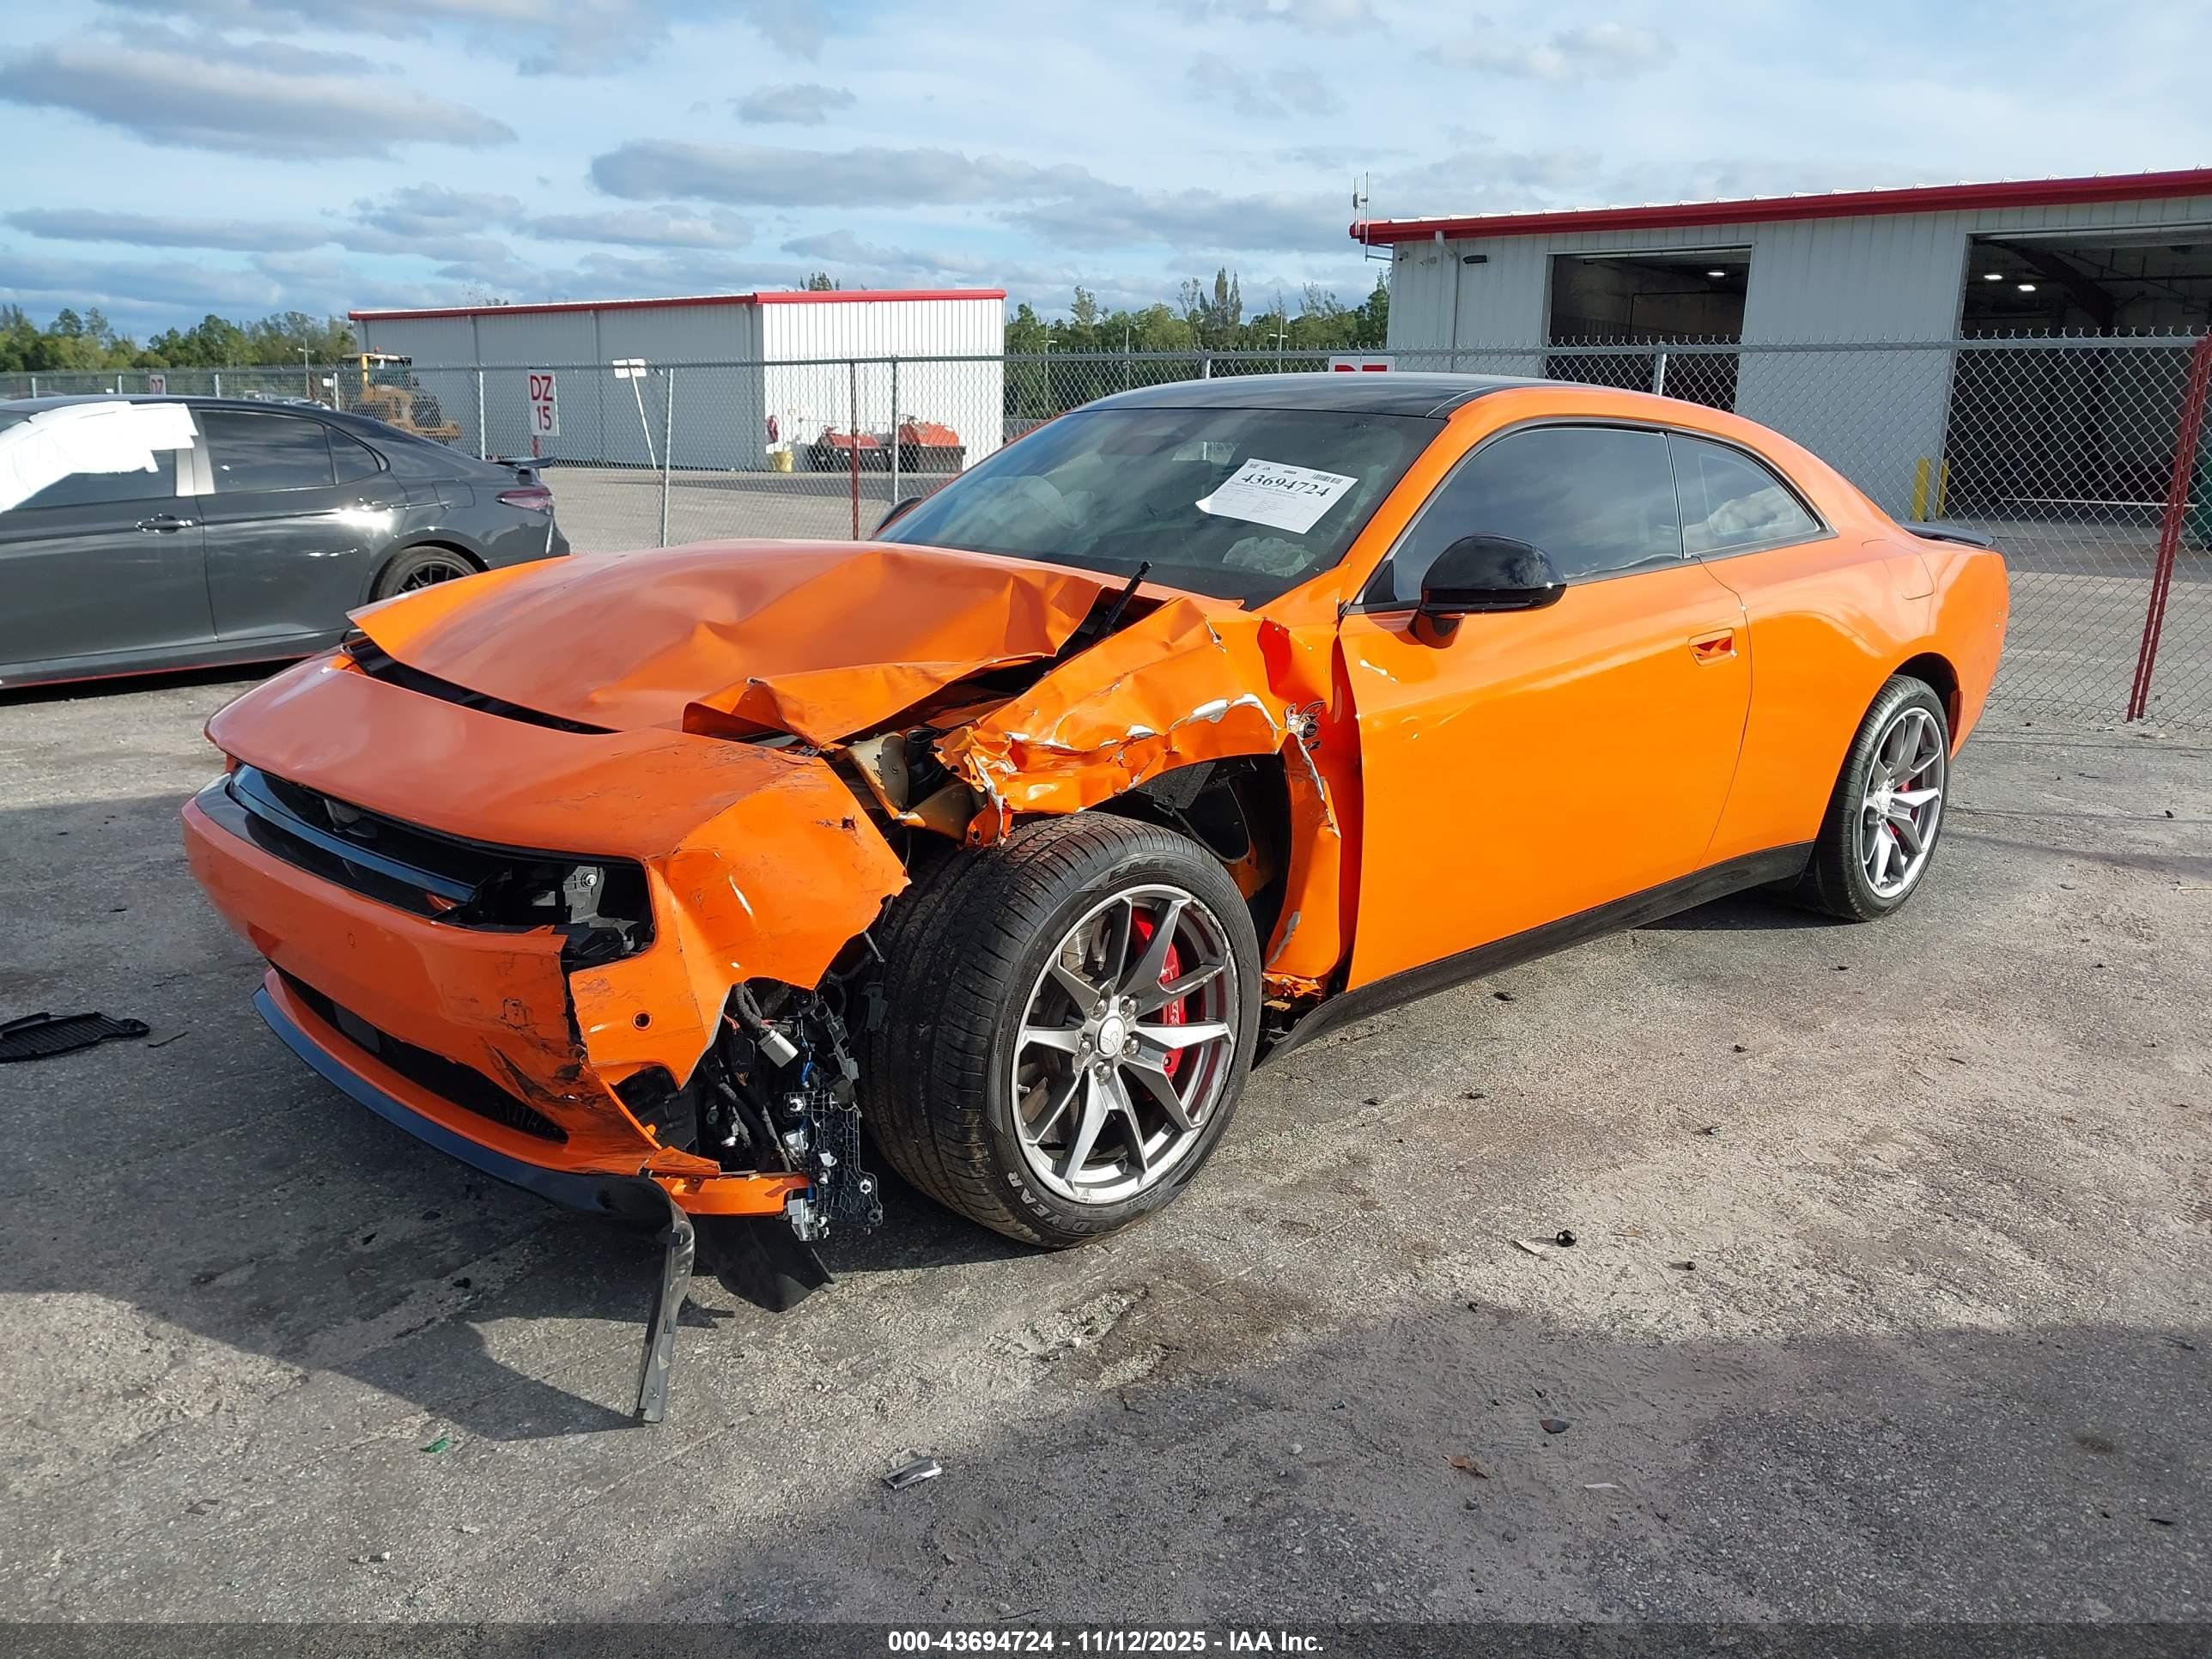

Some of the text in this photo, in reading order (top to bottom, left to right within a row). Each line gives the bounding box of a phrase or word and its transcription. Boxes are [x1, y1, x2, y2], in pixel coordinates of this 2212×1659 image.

[530, 374, 553, 402] DZ
[536, 405, 552, 430] 15
[1242, 473, 1331, 497] 43694724
